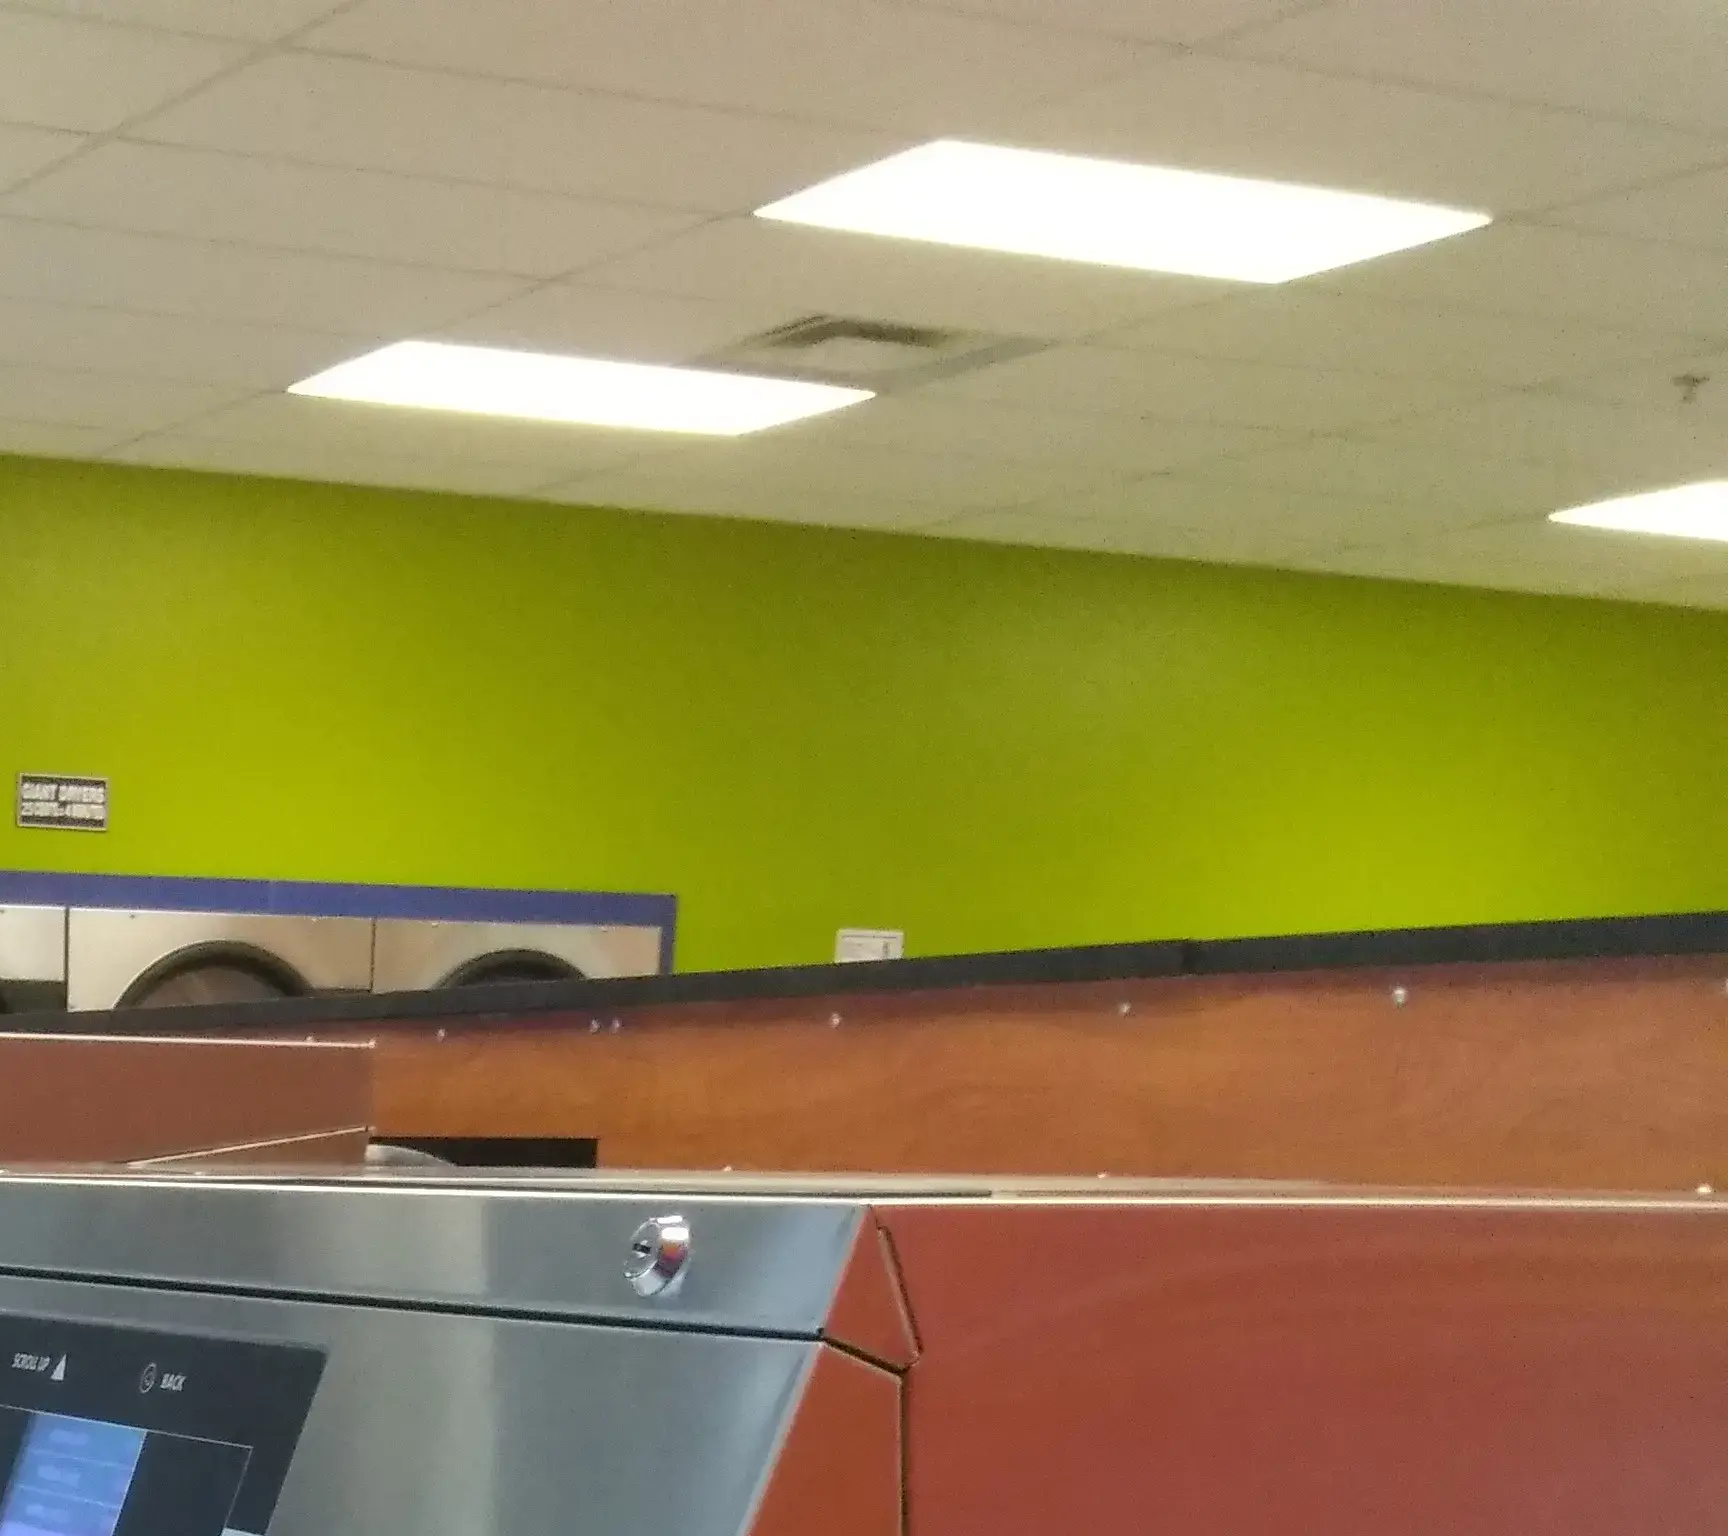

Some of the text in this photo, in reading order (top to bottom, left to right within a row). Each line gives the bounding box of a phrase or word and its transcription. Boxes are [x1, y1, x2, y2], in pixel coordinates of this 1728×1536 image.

[12, 1353, 51, 1372] SCROLL UP
[159, 1373, 187, 1391] BACK
